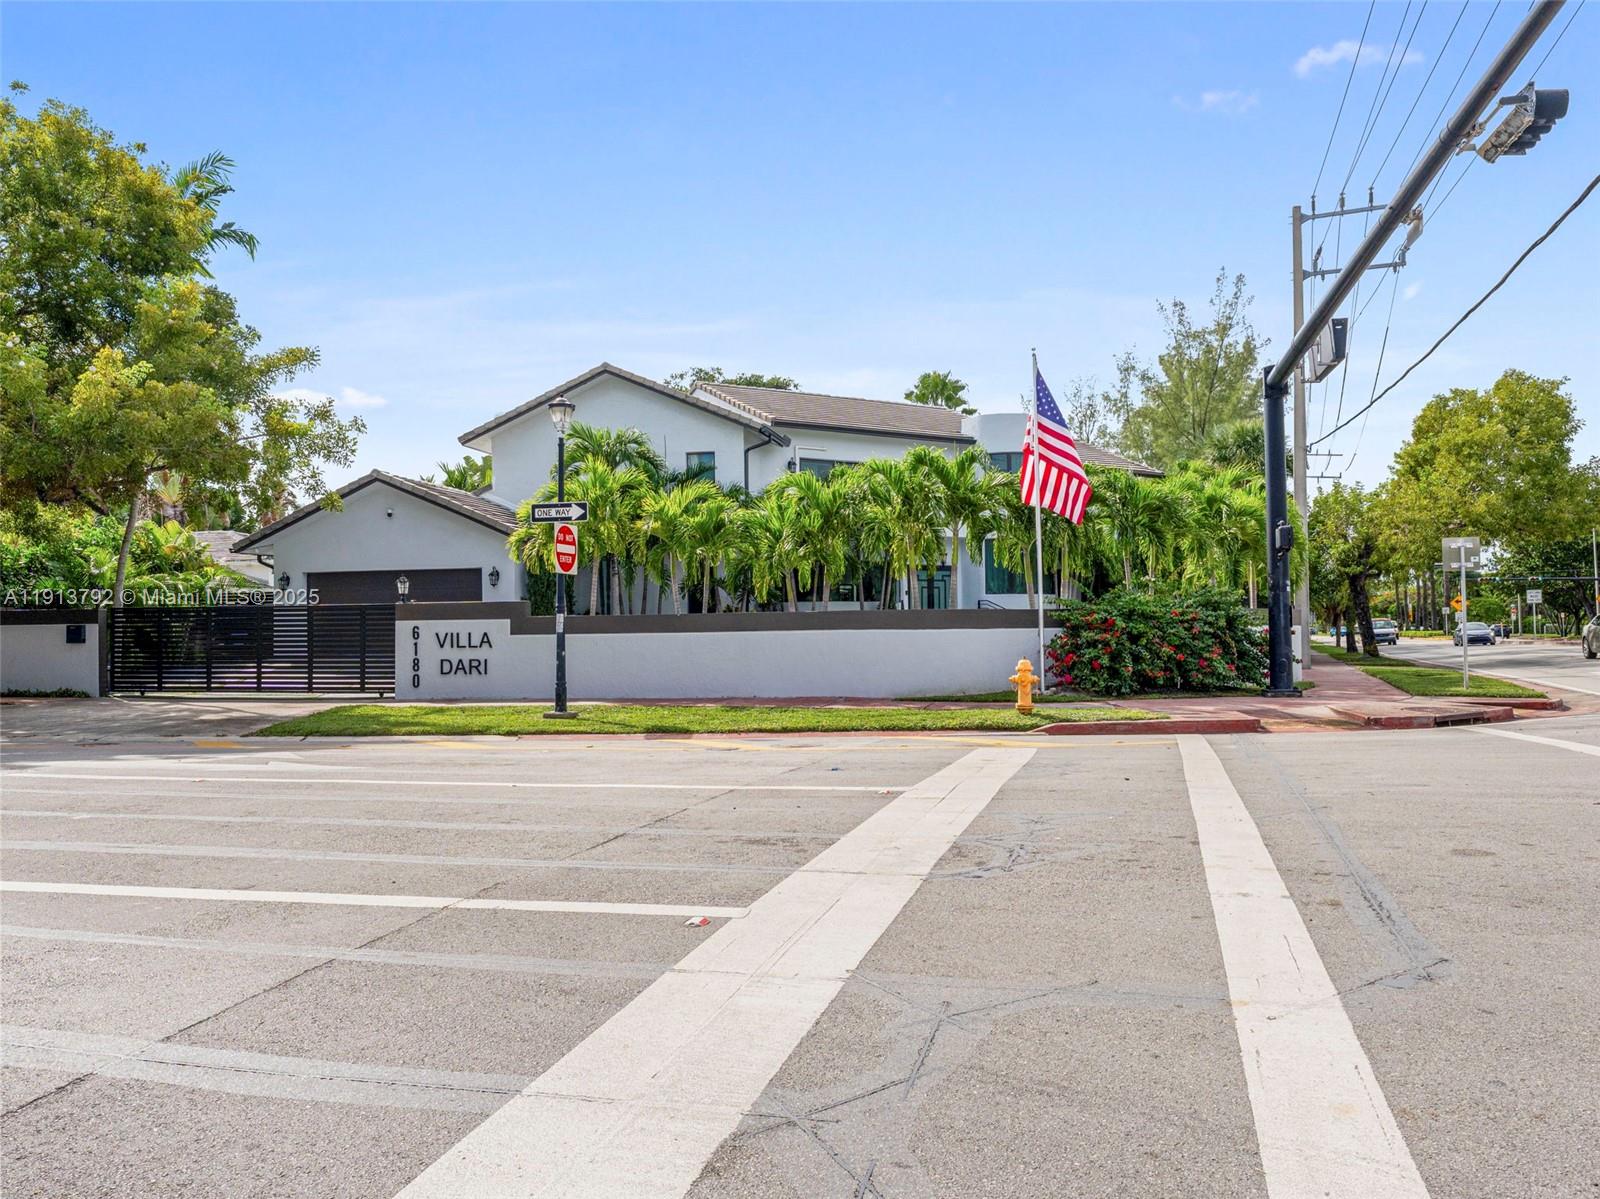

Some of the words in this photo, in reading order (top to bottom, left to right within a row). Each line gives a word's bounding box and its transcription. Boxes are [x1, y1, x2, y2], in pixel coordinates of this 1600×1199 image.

[537, 509, 552, 517] ONE
[555, 508, 571, 516] WAY
[435, 632, 493, 649] VILLA
[440, 658, 488, 675] DARI
